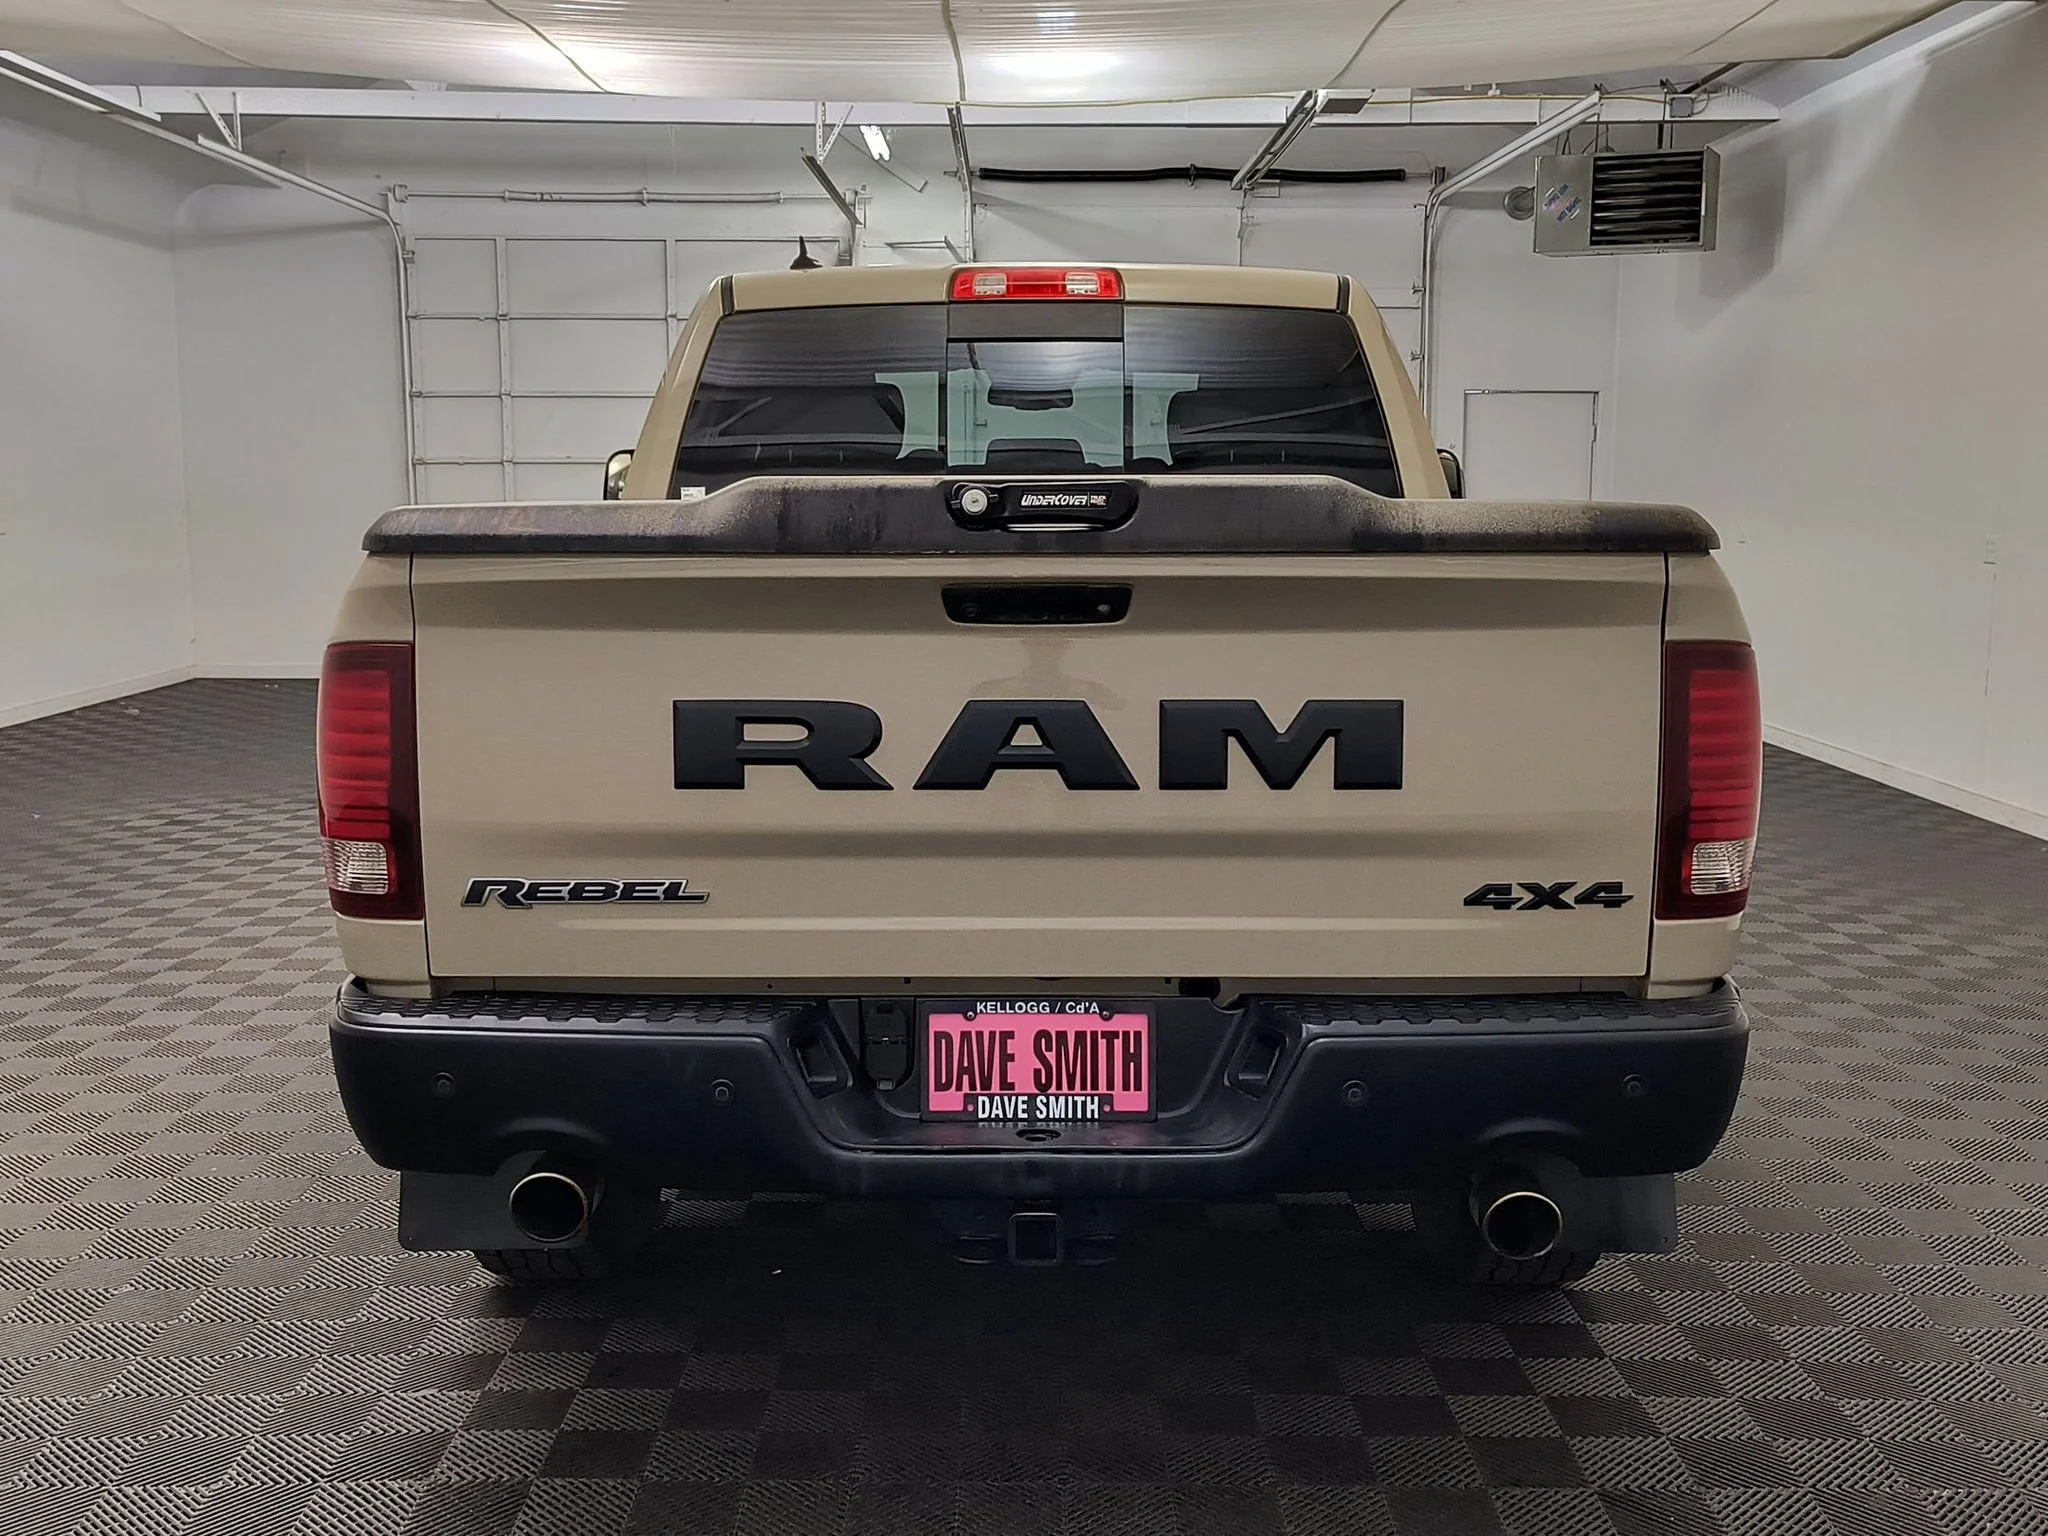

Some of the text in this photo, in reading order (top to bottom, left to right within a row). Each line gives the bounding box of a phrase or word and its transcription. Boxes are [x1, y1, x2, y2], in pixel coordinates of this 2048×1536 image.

[673, 699, 1404, 790] RAM
[461, 877, 710, 909] REBEL
[976, 1001, 1050, 1014] KELLOGG
[934, 1029, 1143, 1093] DAVE SMITH
[978, 1095, 1099, 1119] DAVE SMITH
